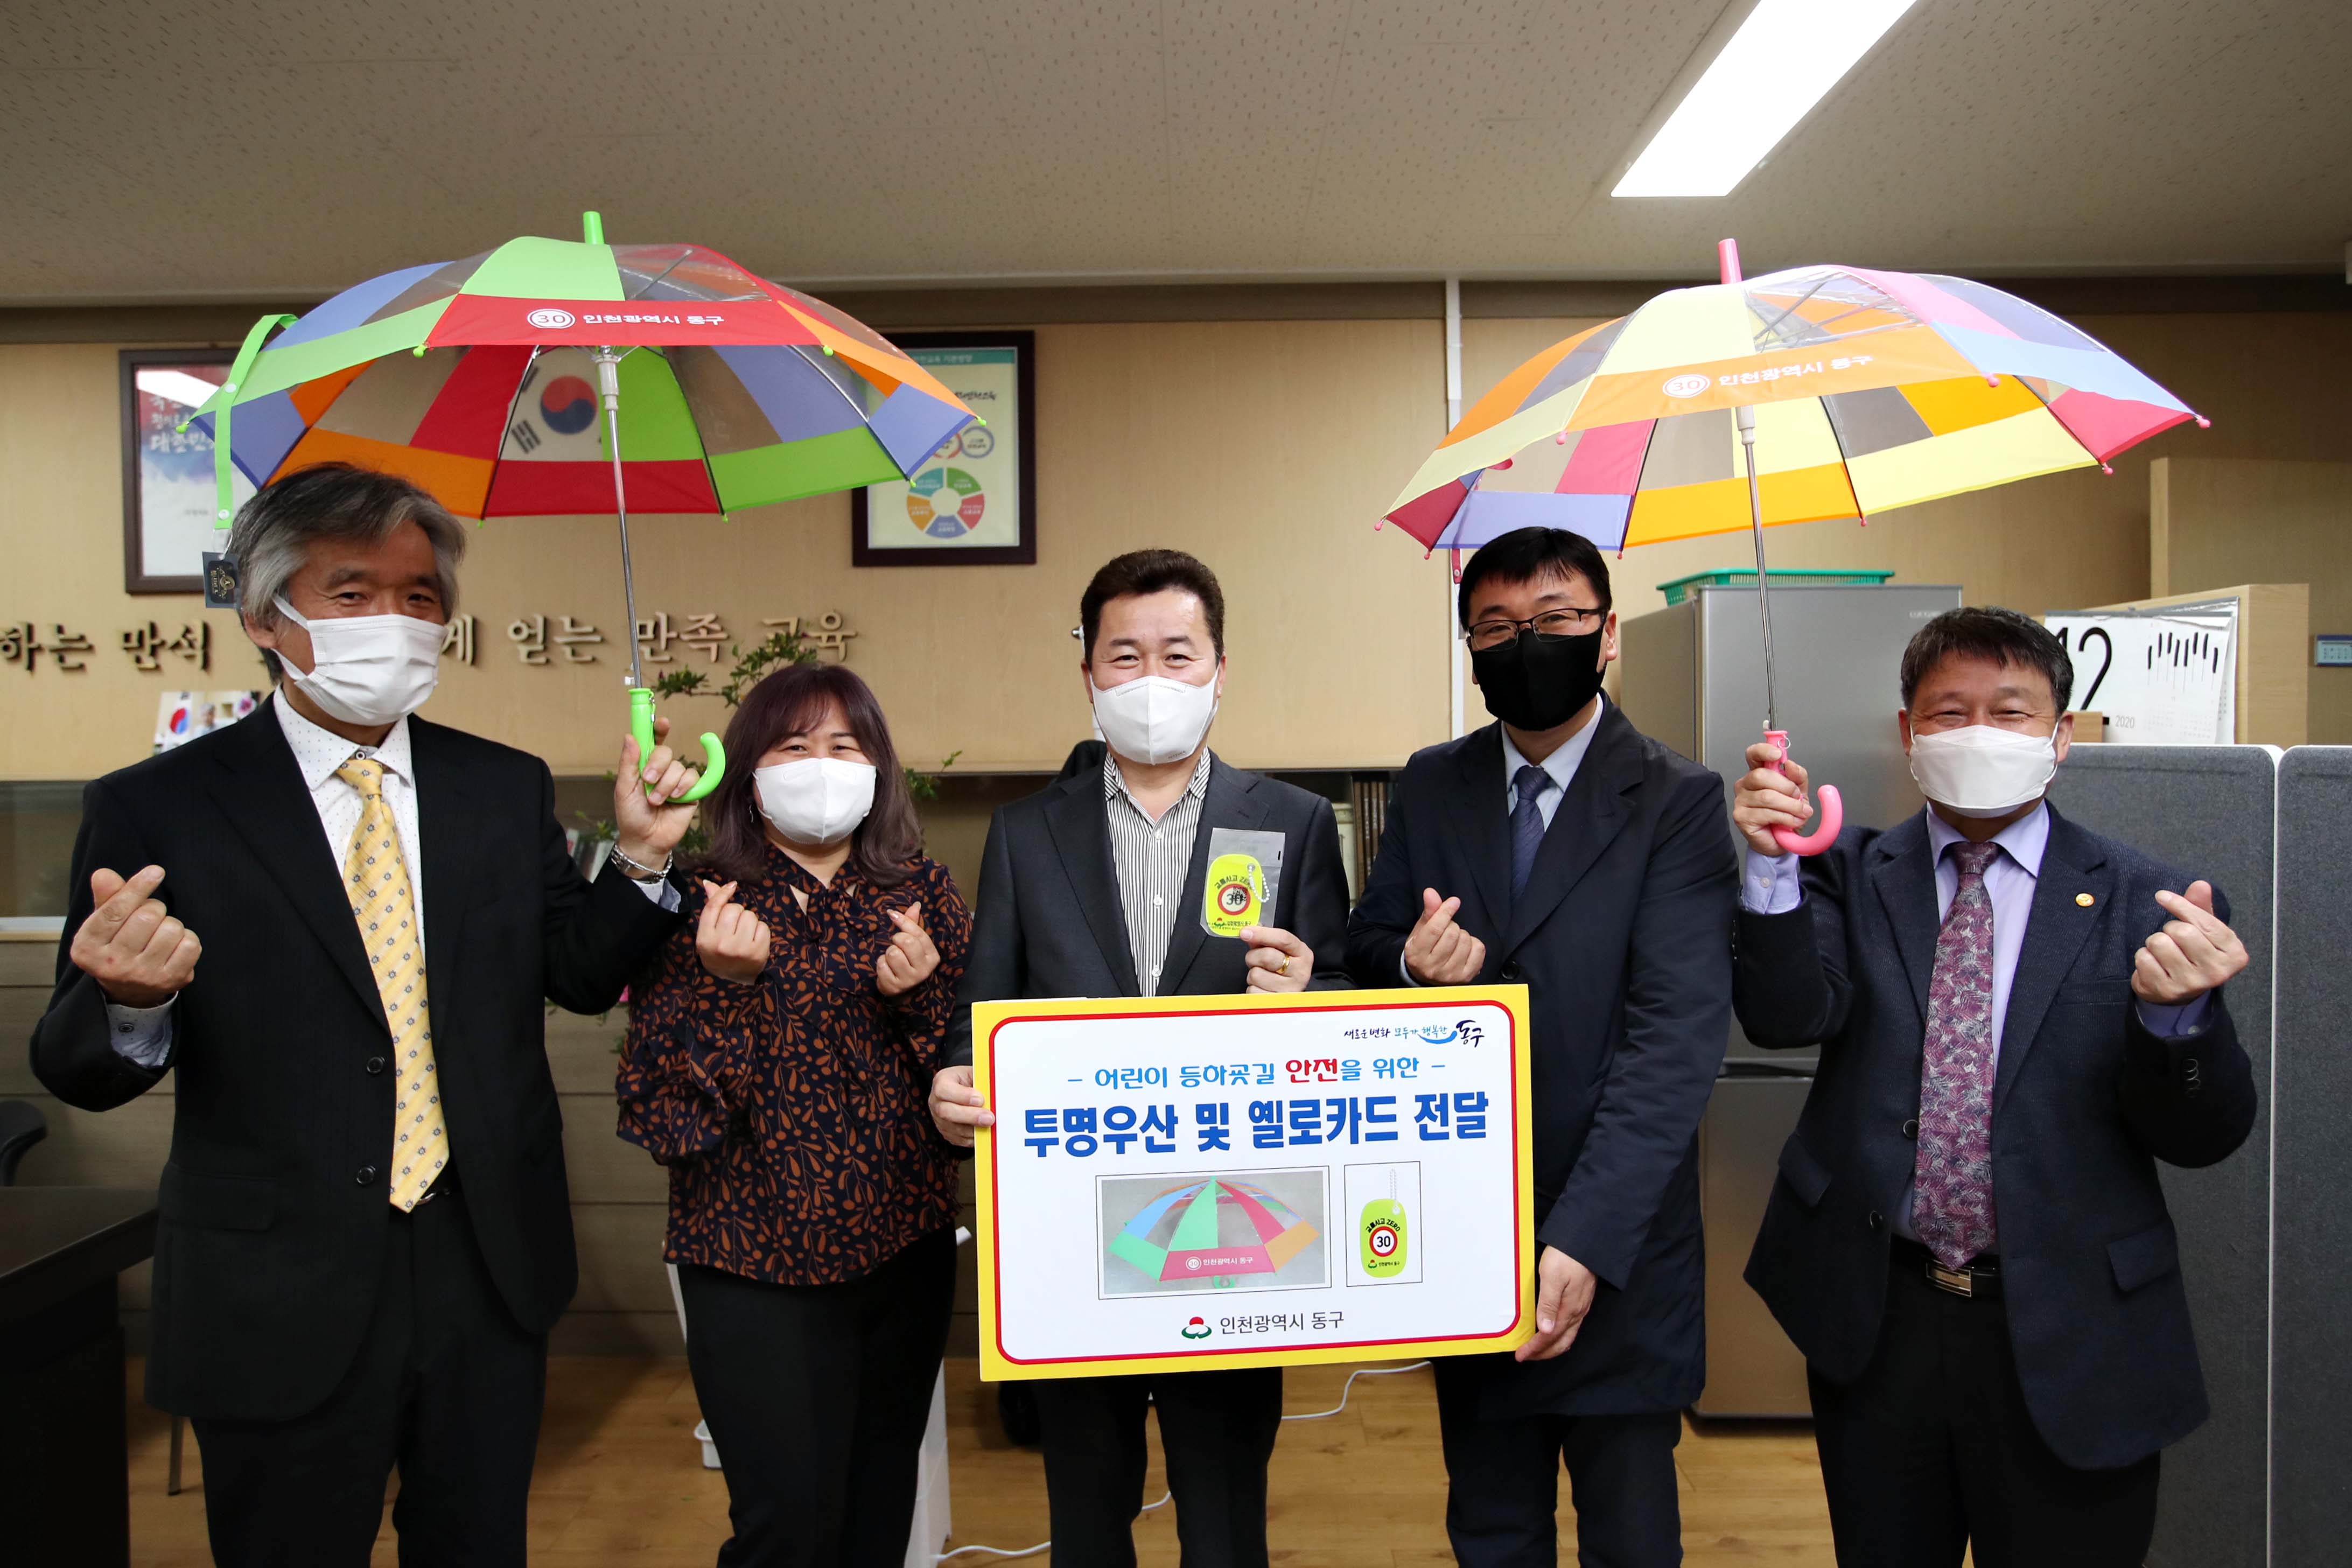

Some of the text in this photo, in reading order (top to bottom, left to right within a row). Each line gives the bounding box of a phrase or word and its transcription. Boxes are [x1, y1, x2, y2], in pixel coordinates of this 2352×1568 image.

[537, 315, 566, 323] 30
[583, 314, 724, 325] 인천광역시 동구
[1718, 355, 1874, 386] 인천광역시 동구
[1672, 379, 1700, 391] 30
[120, 621, 212, 674] 만석
[507, 613, 604, 666] 얻는
[636, 611, 730, 663] 만족
[2115, 715, 2136, 729] 2020
[1344, 1019, 1485, 1048] 새로운 변화 모두가 행복한 동구
[1095, 1057, 1419, 1090] 어린이 등하굣길 안전을 위한
[1024, 1091, 1489, 1158] 투명우산 및 옐로카드 전달
[1386, 1219, 1401, 1233] ZERO
[1377, 1236, 1391, 1248] 30
[1203, 1256, 1254, 1266] 인천광역시 동구
[1220, 1311, 1345, 1335] 인천광역시 동구
